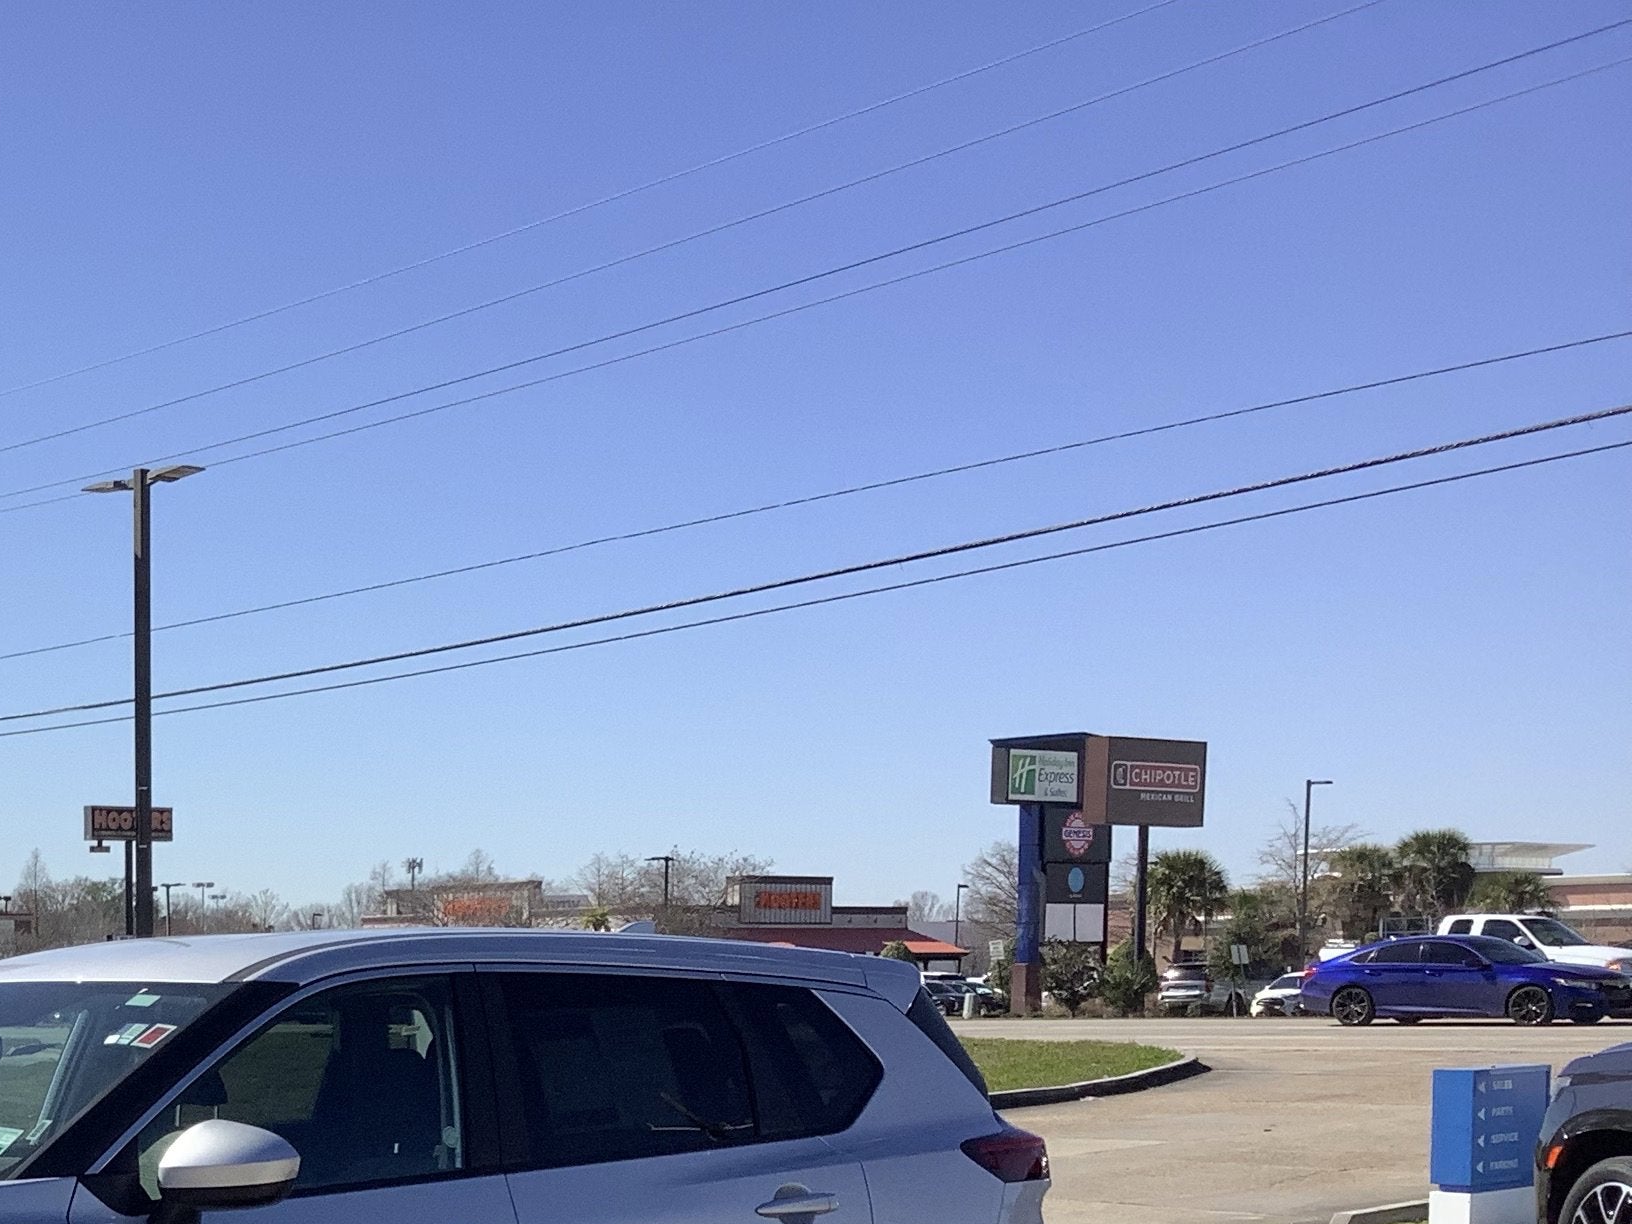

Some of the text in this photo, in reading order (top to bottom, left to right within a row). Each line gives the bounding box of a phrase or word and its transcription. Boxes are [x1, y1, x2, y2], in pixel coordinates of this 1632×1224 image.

[1037, 768, 1075, 786] Express
[1131, 768, 1197, 786] CHIPOTLE
[1140, 792, 1194, 803] MEXICAN GRILL
[94, 809, 172, 831] HOORS
[1063, 829, 1092, 839] GENESIS
[1490, 1132, 1519, 1144] SERVICE
